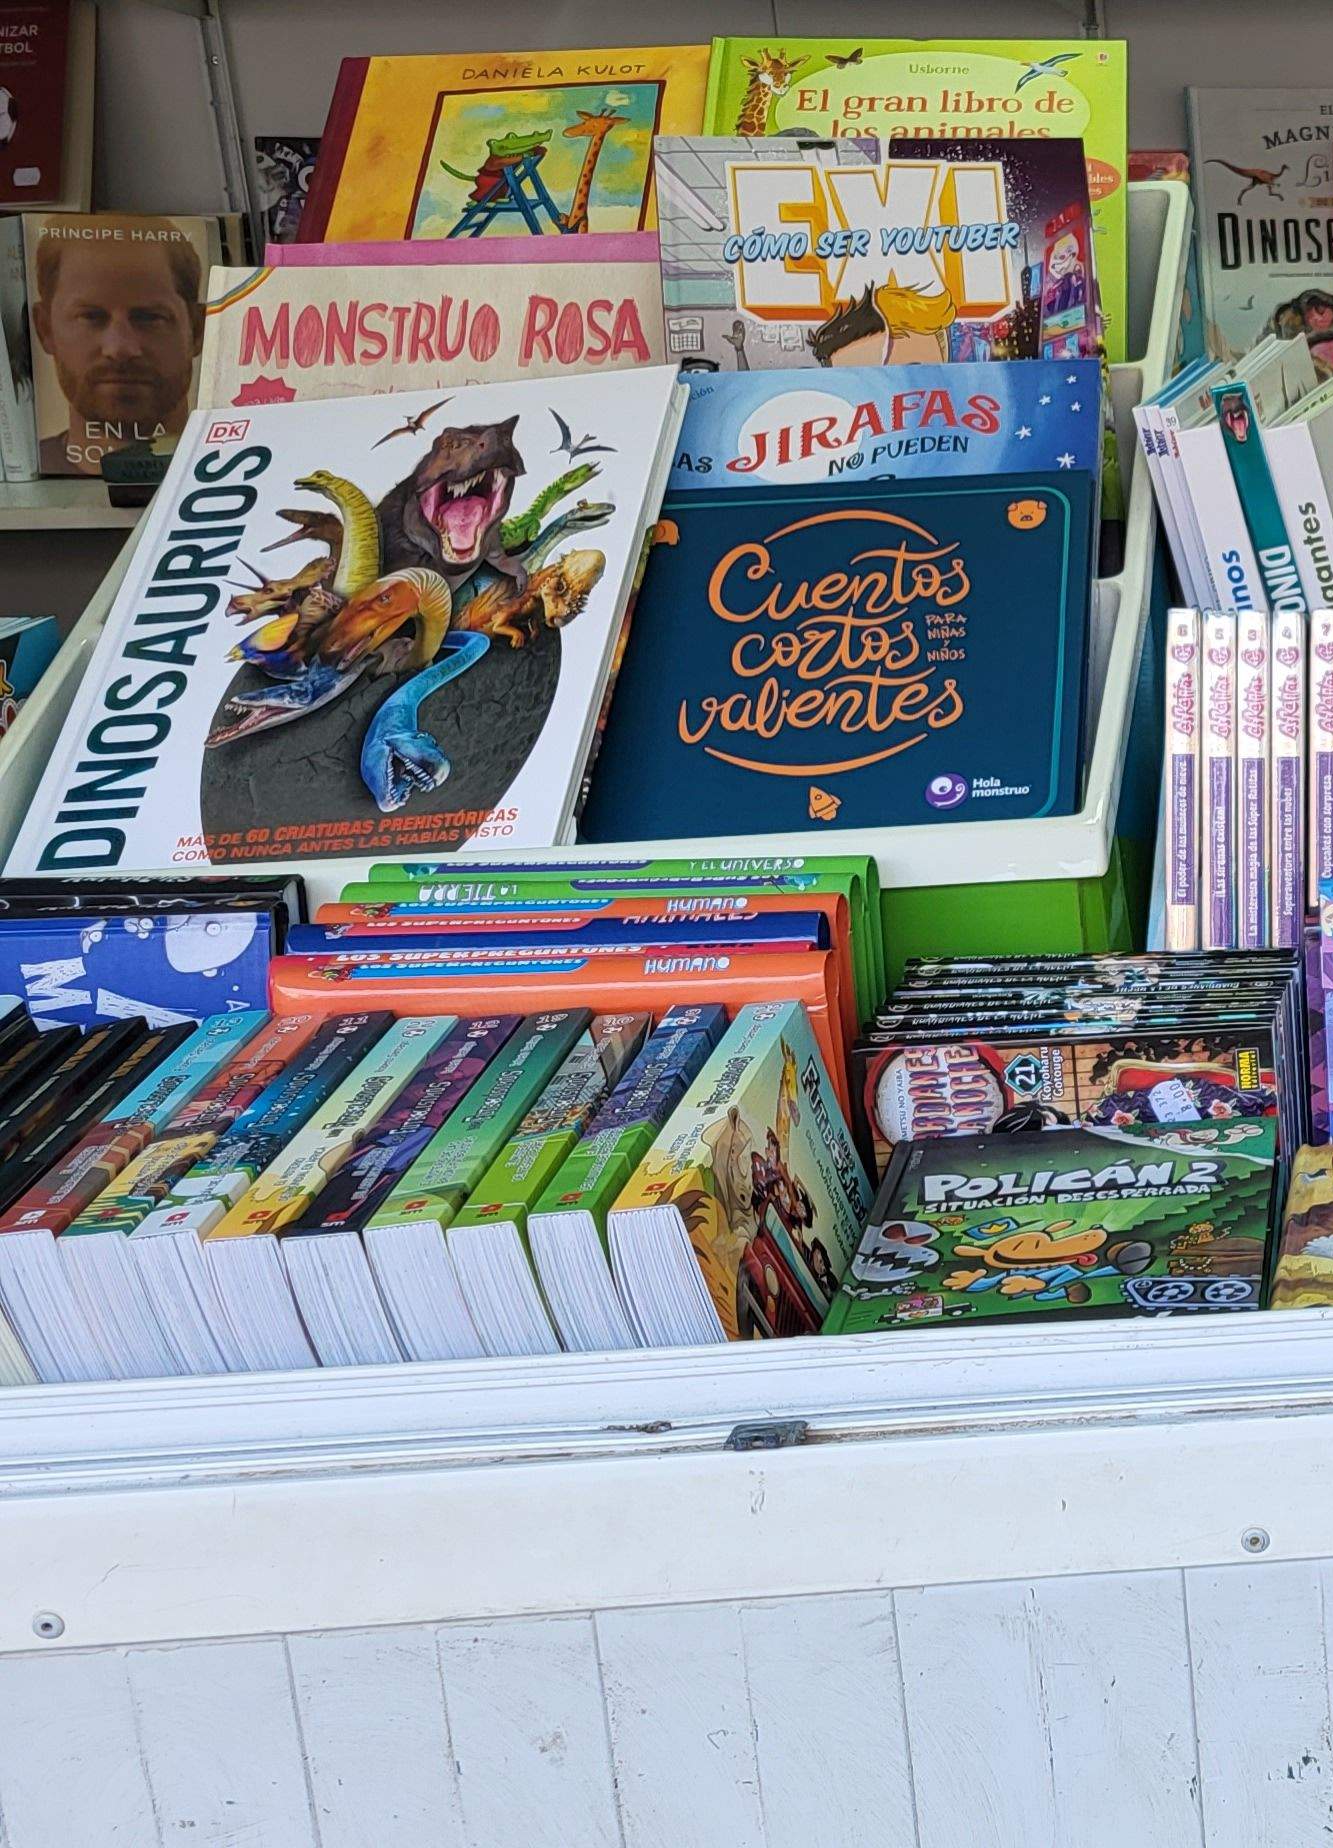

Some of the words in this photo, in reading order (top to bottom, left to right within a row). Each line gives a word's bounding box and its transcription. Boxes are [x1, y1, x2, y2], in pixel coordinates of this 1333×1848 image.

[461, 65, 564, 81] DANIELA
[576, 62, 647, 78] KULOT
[908, 62, 970, 75] Usborne
[796, 90, 831, 113] El
[842, 95, 928, 118] gran
[941, 89, 1023, 114] libro
[1034, 90, 1074, 114] de
[831, 119, 883, 139] los
[891, 120, 1052, 139] animales
[37, 226, 125, 242] PRÍNCIPE
[130, 228, 194, 242] HARRY
[723, 224, 808, 263] CÓMO
[816, 228, 871, 259] SER
[879, 220, 1021, 258] YOUTUBER
[238, 294, 501, 369] MONSTRUO
[517, 294, 653, 367] ROSA
[85, 420, 125, 440] EN
[211, 423, 245, 440] DK
[725, 388, 1003, 476] JIRAFAS
[828, 451, 865, 477] NO
[872, 434, 971, 462] PUEDEN
[708, 540, 973, 625] Cuentos
[924, 612, 968, 625] PARA
[926, 625, 966, 639] NIÑAS
[731, 607, 920, 681] cortos
[37, 444, 273, 872] DINOSAURIOS
[926, 647, 966, 662] NIÑOS
[676, 665, 965, 745] valientes
[972, 777, 1001, 789] Hola
[972, 782, 1029, 797] monstruo
[218, 833, 243, 846] DE
[247, 829, 269, 843] 60
[275, 819, 374, 840] CRIATURAS
[172, 848, 227, 862] COMO
[231, 845, 292, 858] NUNCA
[298, 839, 351, 854] ANTES
[358, 834, 391, 848] LAS
[464, 824, 514, 839] VISTO
[719, 858, 805, 872] UNIVERSO
[644, 956, 731, 975] HUMANO
[1014, 1065, 1036, 1084] 21
[1053, 1049, 1065, 1097] Gotouge
[922, 1160, 1174, 1202] POLICÁN
[1179, 1162, 1220, 1184] 2
[923, 1195, 1045, 1214] SITUACIÓN
